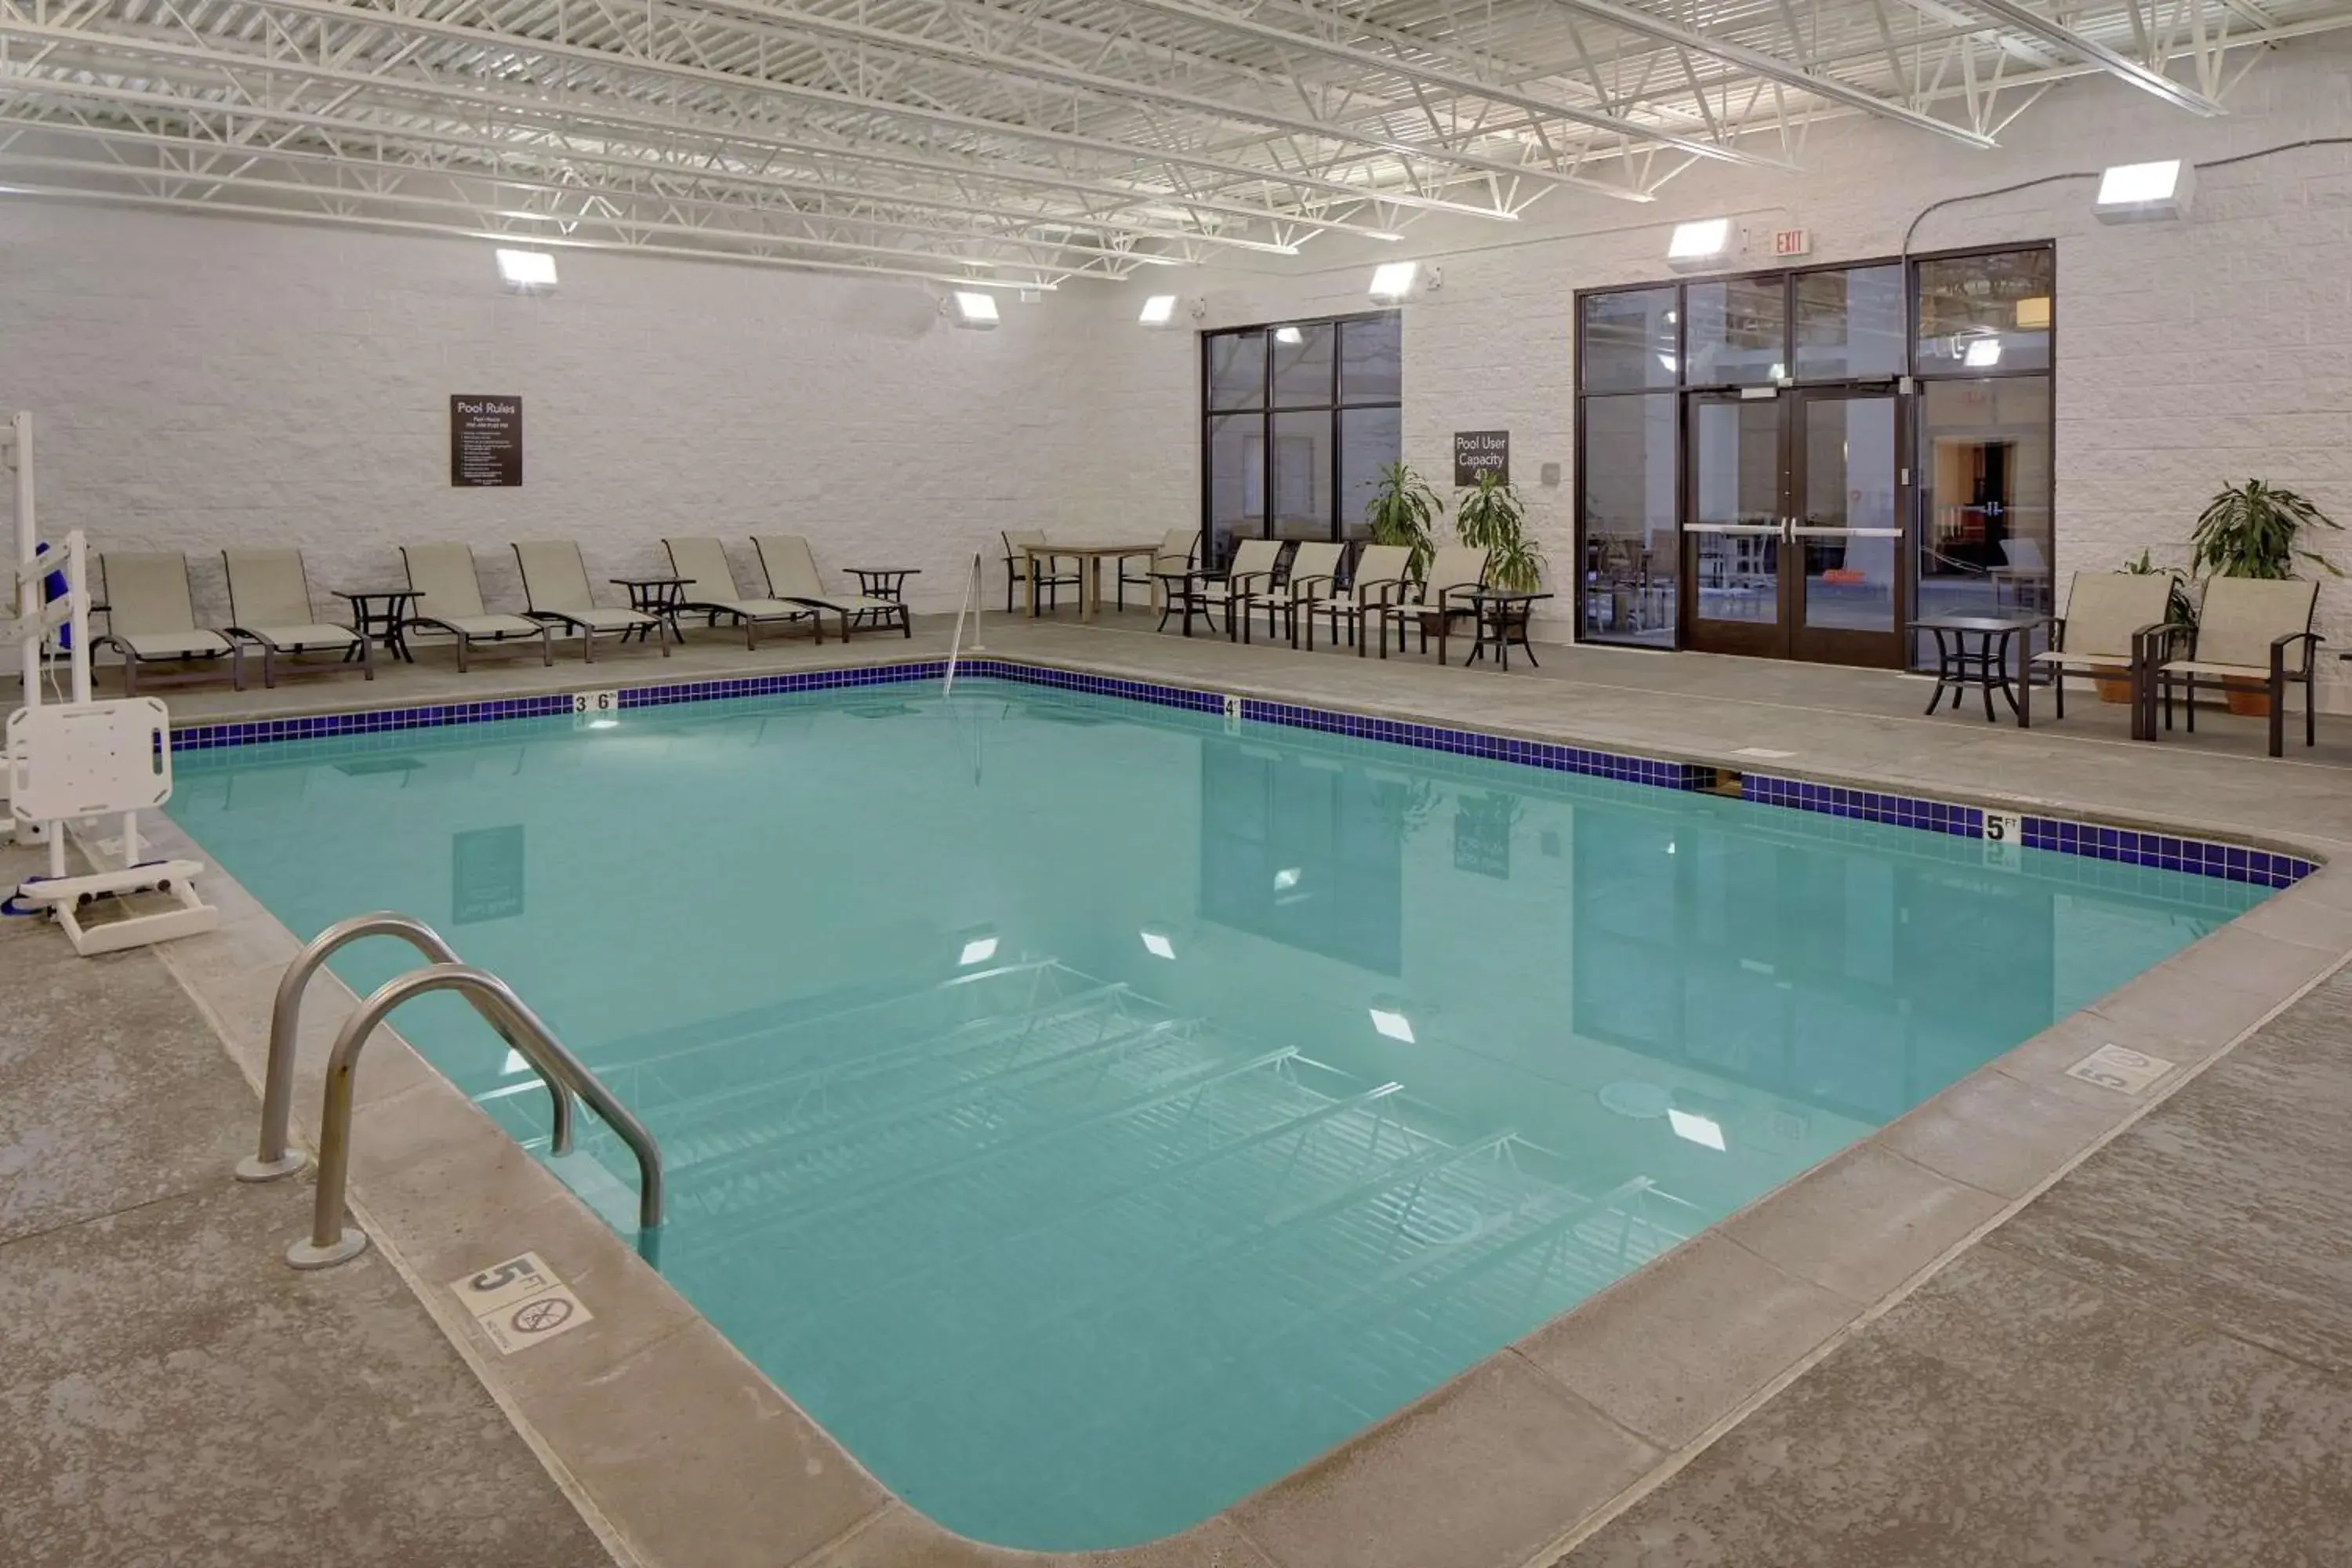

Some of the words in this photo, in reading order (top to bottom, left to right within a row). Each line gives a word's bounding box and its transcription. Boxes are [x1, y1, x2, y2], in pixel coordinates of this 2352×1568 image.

[1777, 230, 1802, 253] EXIT
[457, 401, 482, 414] Pool
[486, 402, 515, 415] Rules
[1457, 435, 1479, 449] Pool
[1483, 436, 1505, 449] User
[1459, 452, 1504, 469] Capacity
[576, 696, 586, 712] 3
[598, 694, 608, 710] 6
[1225, 700, 1234, 716] 4
[1987, 815, 2004, 840] 5
[2005, 818, 2017, 828] FT
[469, 1258, 536, 1292] 5
